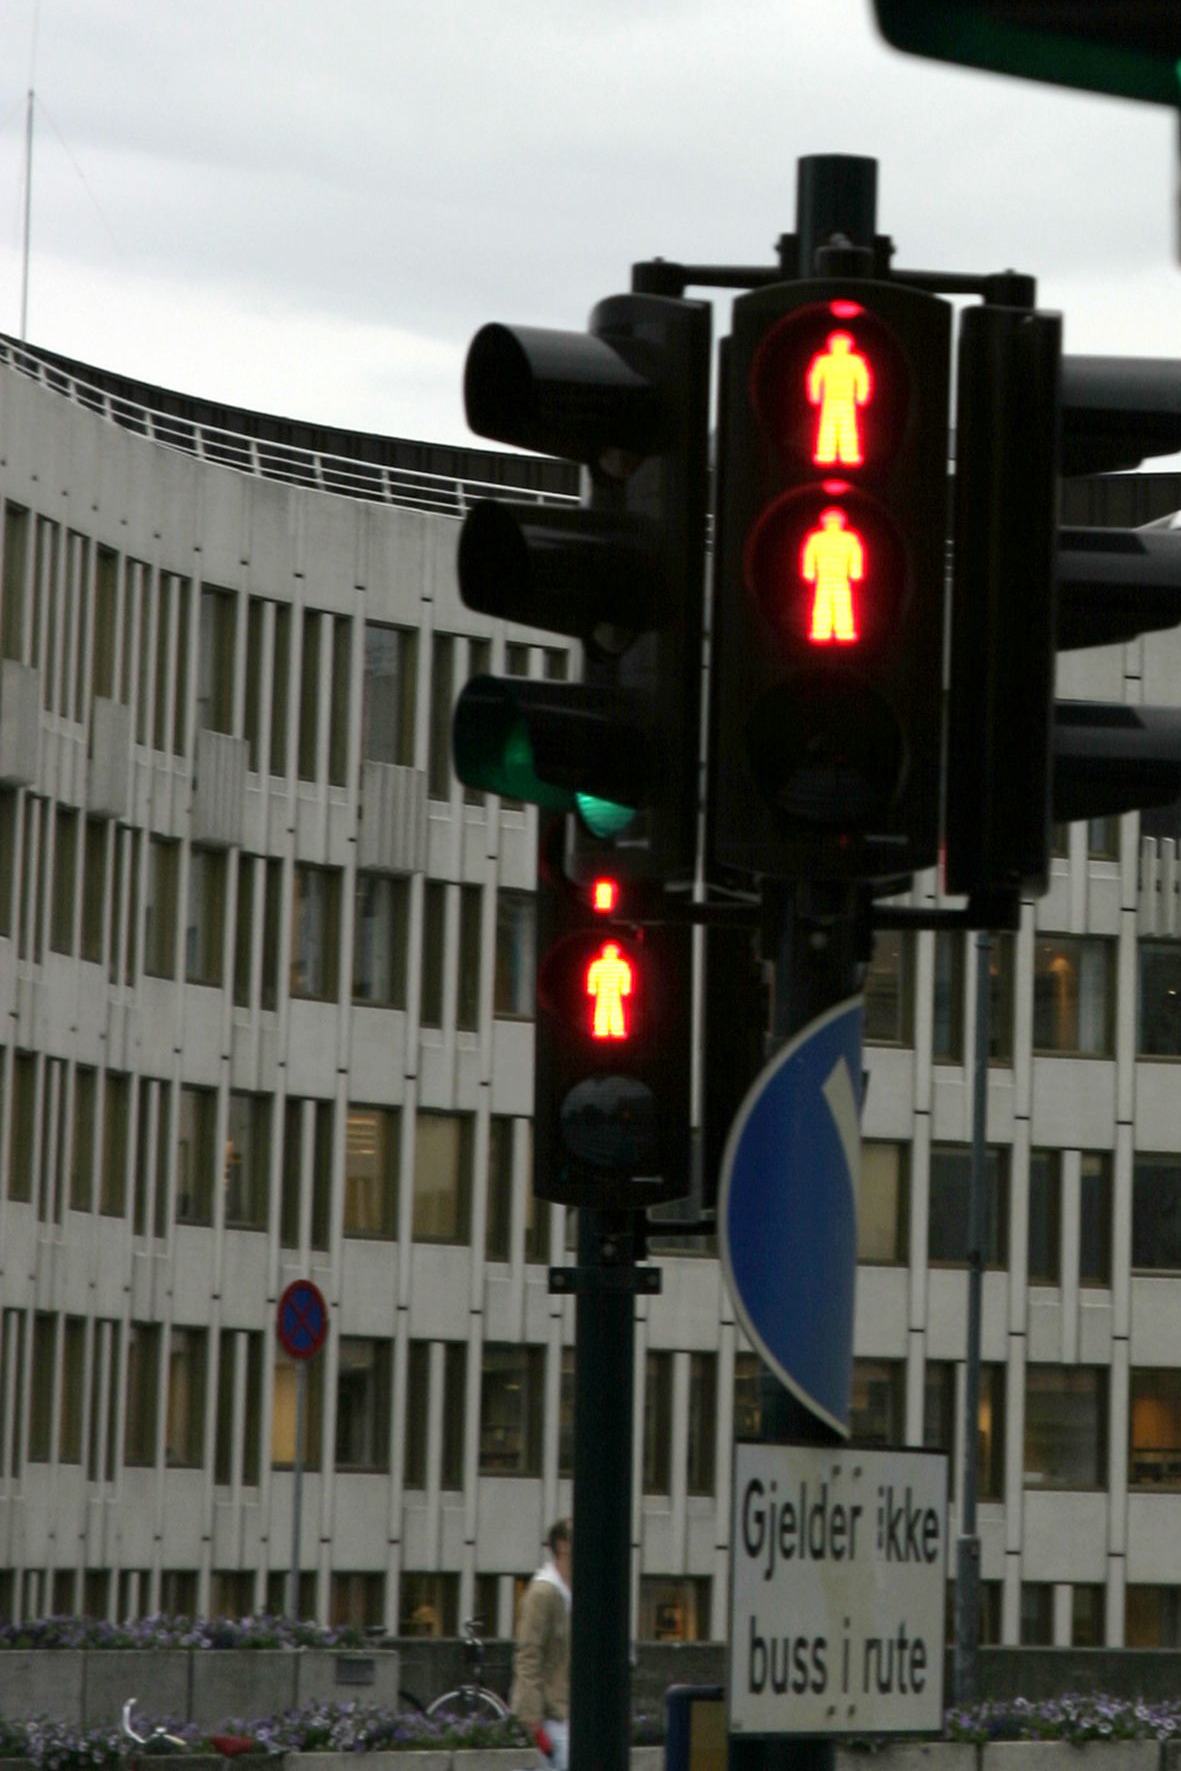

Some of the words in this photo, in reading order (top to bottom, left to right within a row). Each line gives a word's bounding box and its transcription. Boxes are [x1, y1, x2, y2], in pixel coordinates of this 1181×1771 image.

[742, 1478, 862, 1581] Gjelder
[877, 1485, 940, 1563] ikke
[748, 1615, 828, 1695] buss
[840, 1617, 852, 1694] i
[863, 1622, 928, 1695] rute
